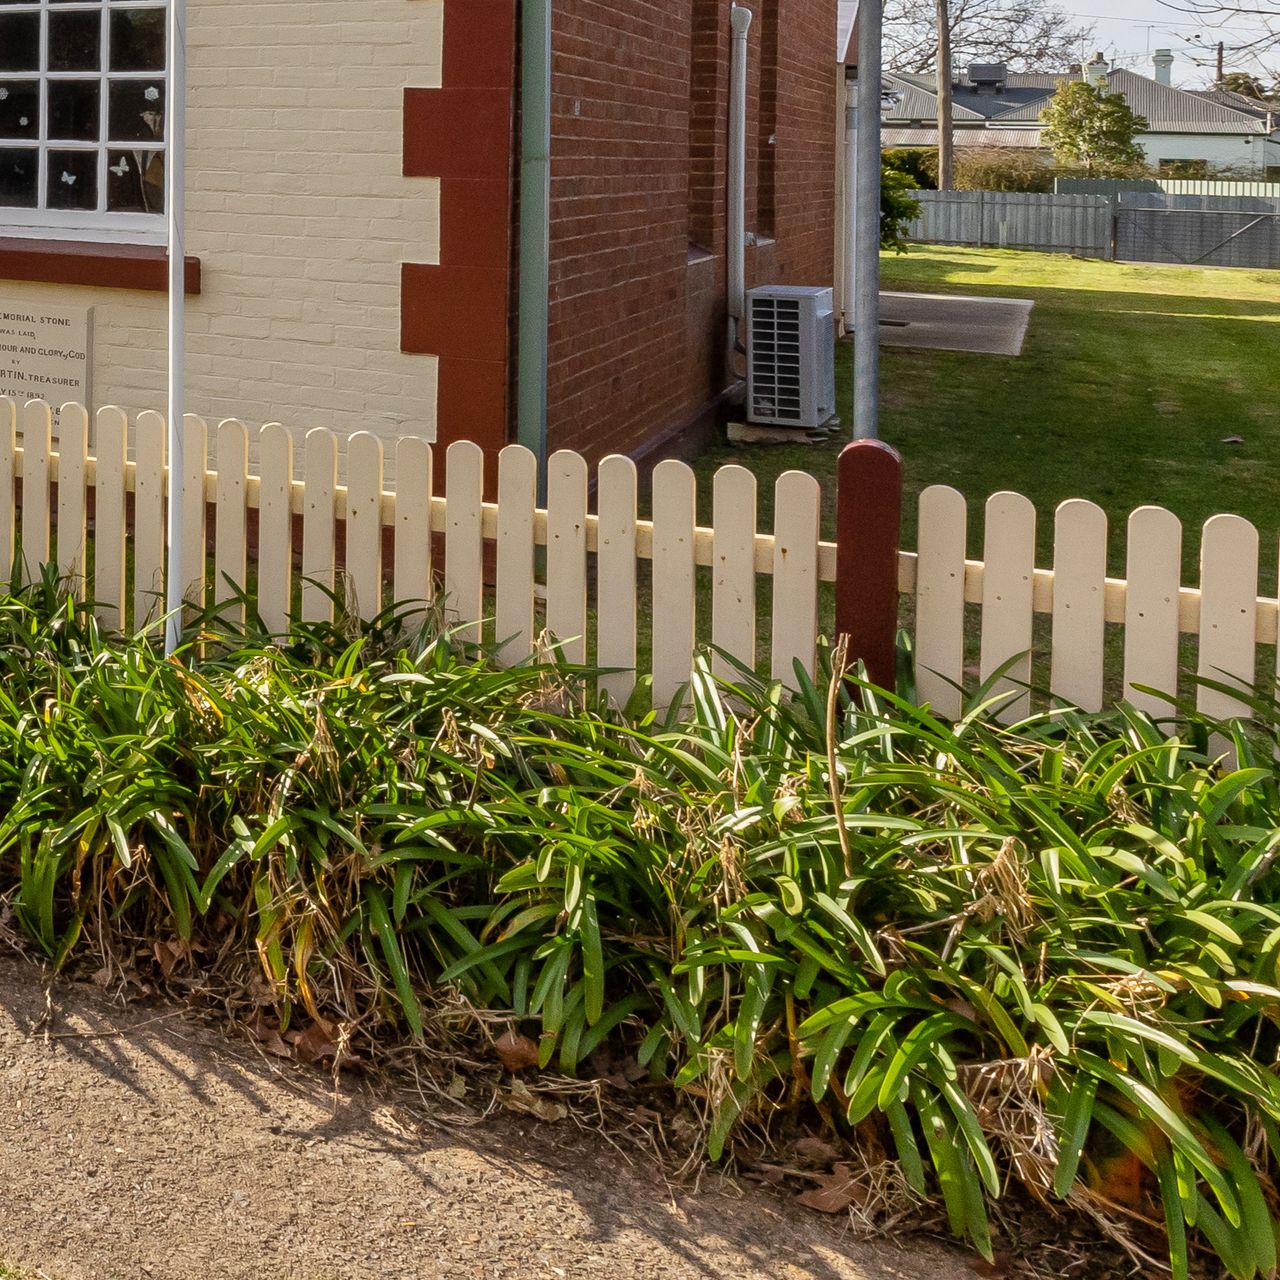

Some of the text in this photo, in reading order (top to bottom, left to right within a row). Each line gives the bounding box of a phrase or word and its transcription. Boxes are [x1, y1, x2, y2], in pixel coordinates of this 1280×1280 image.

[40, 316, 71, 327] STONE
[20, 346, 36, 355] AND
[28, 374, 80, 387] TREASURER
[26, 391, 45, 400] 1892
